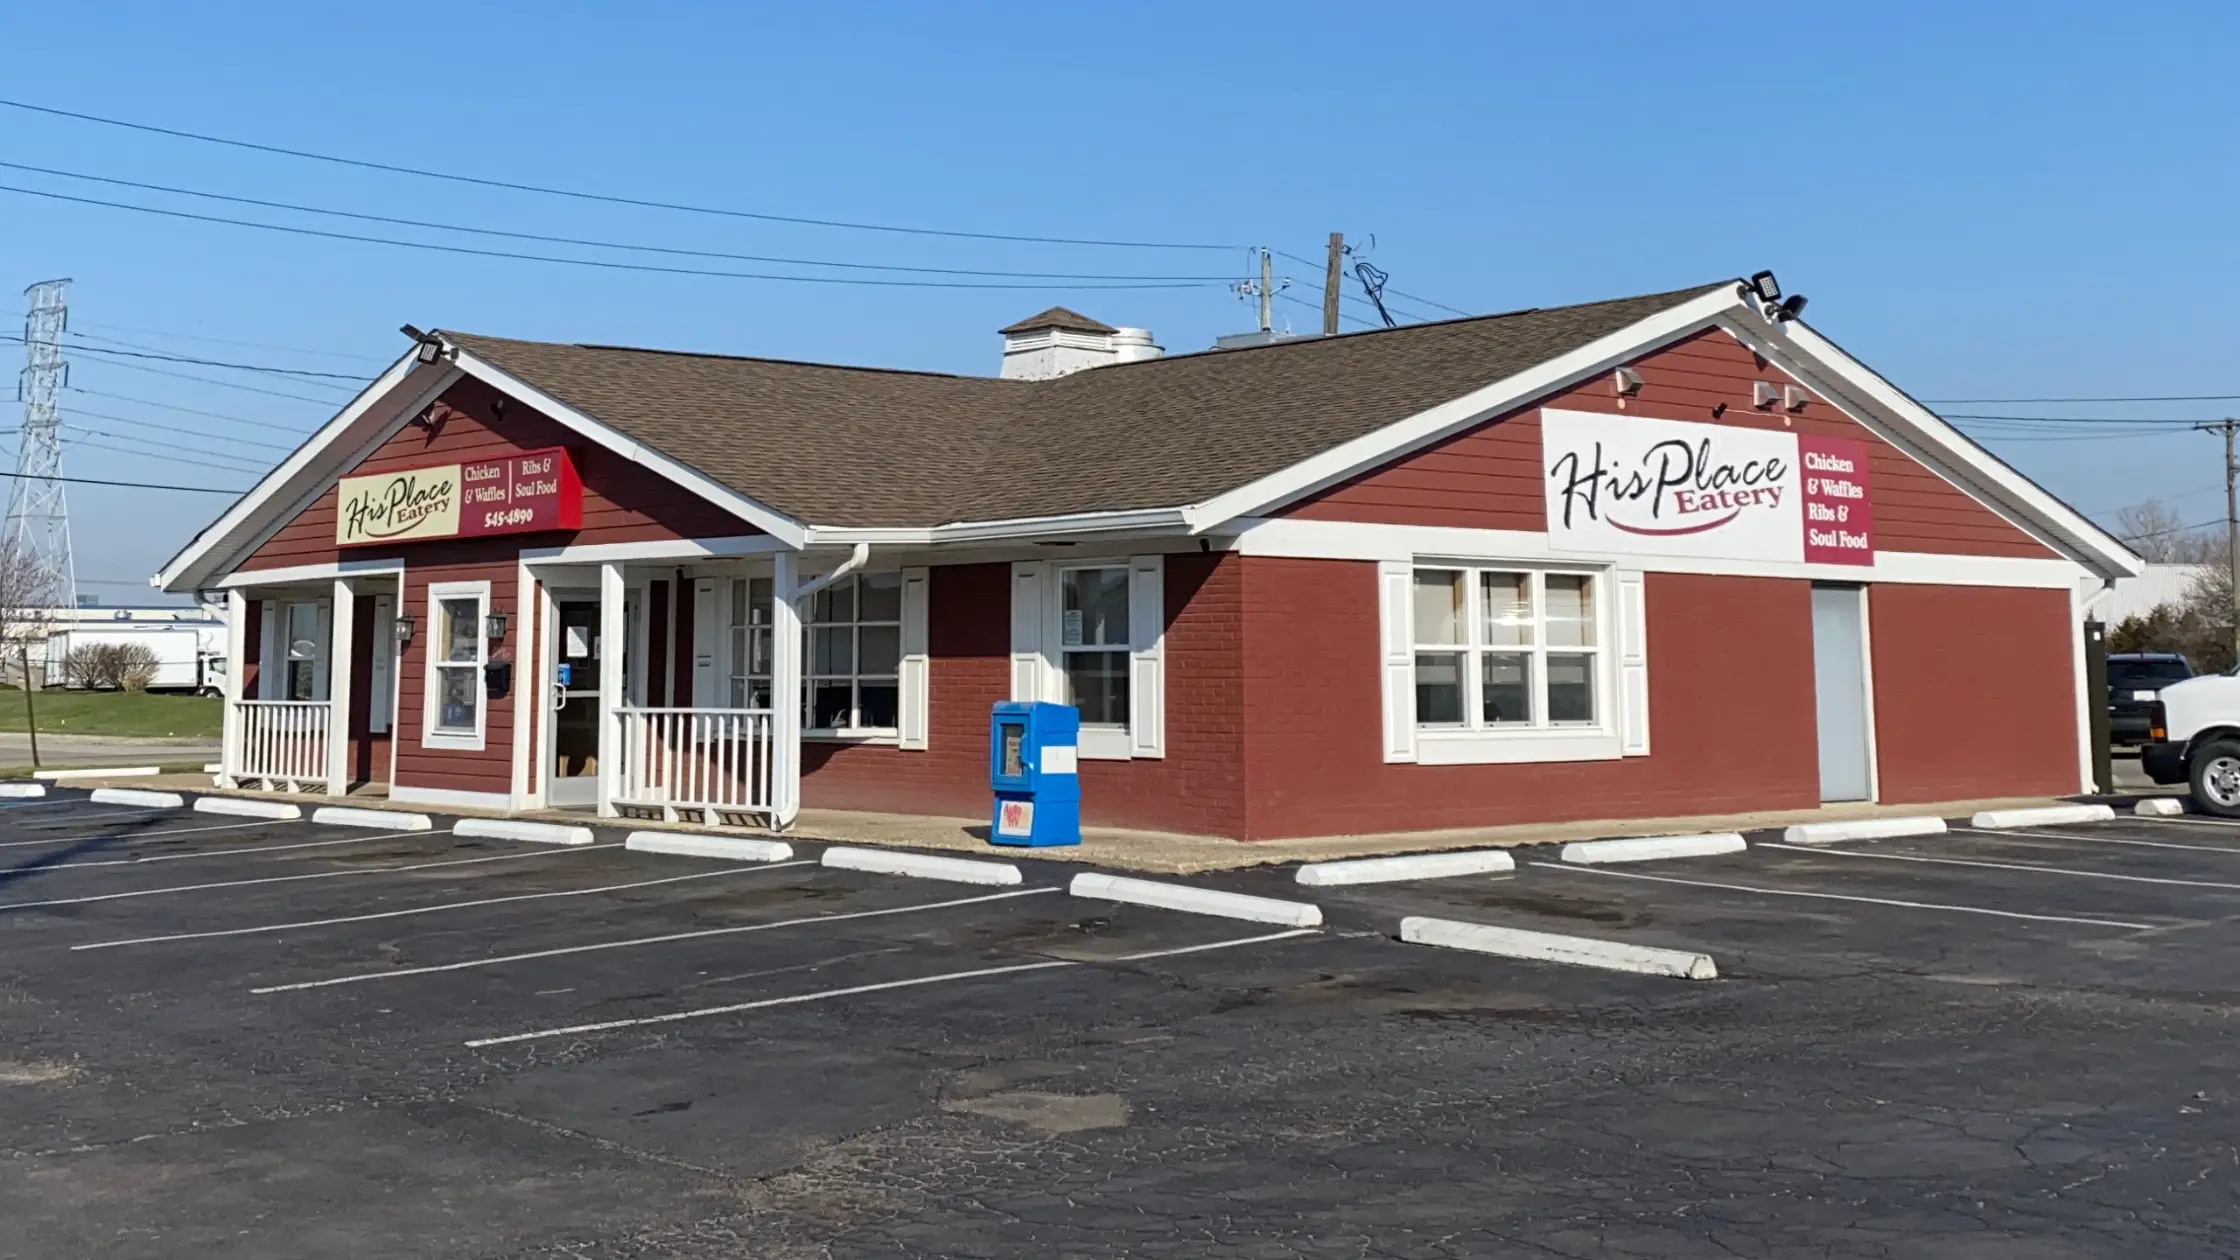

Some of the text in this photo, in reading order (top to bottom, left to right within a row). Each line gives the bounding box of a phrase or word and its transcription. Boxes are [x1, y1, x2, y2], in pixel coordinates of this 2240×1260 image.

[522, 458, 551, 475] Ribs &
[1805, 452, 1854, 473] Chicken
[465, 464, 500, 482] Chicken
[464, 486, 506, 504] & Waffles
[515, 479, 557, 498] Soul Food
[1807, 478, 1863, 499] & Waffles
[1674, 485, 1784, 514] Eatery
[397, 497, 450, 524] Eatery
[1808, 503, 1849, 522] Ribs &
[1810, 528, 1868, 549] Soul Food
